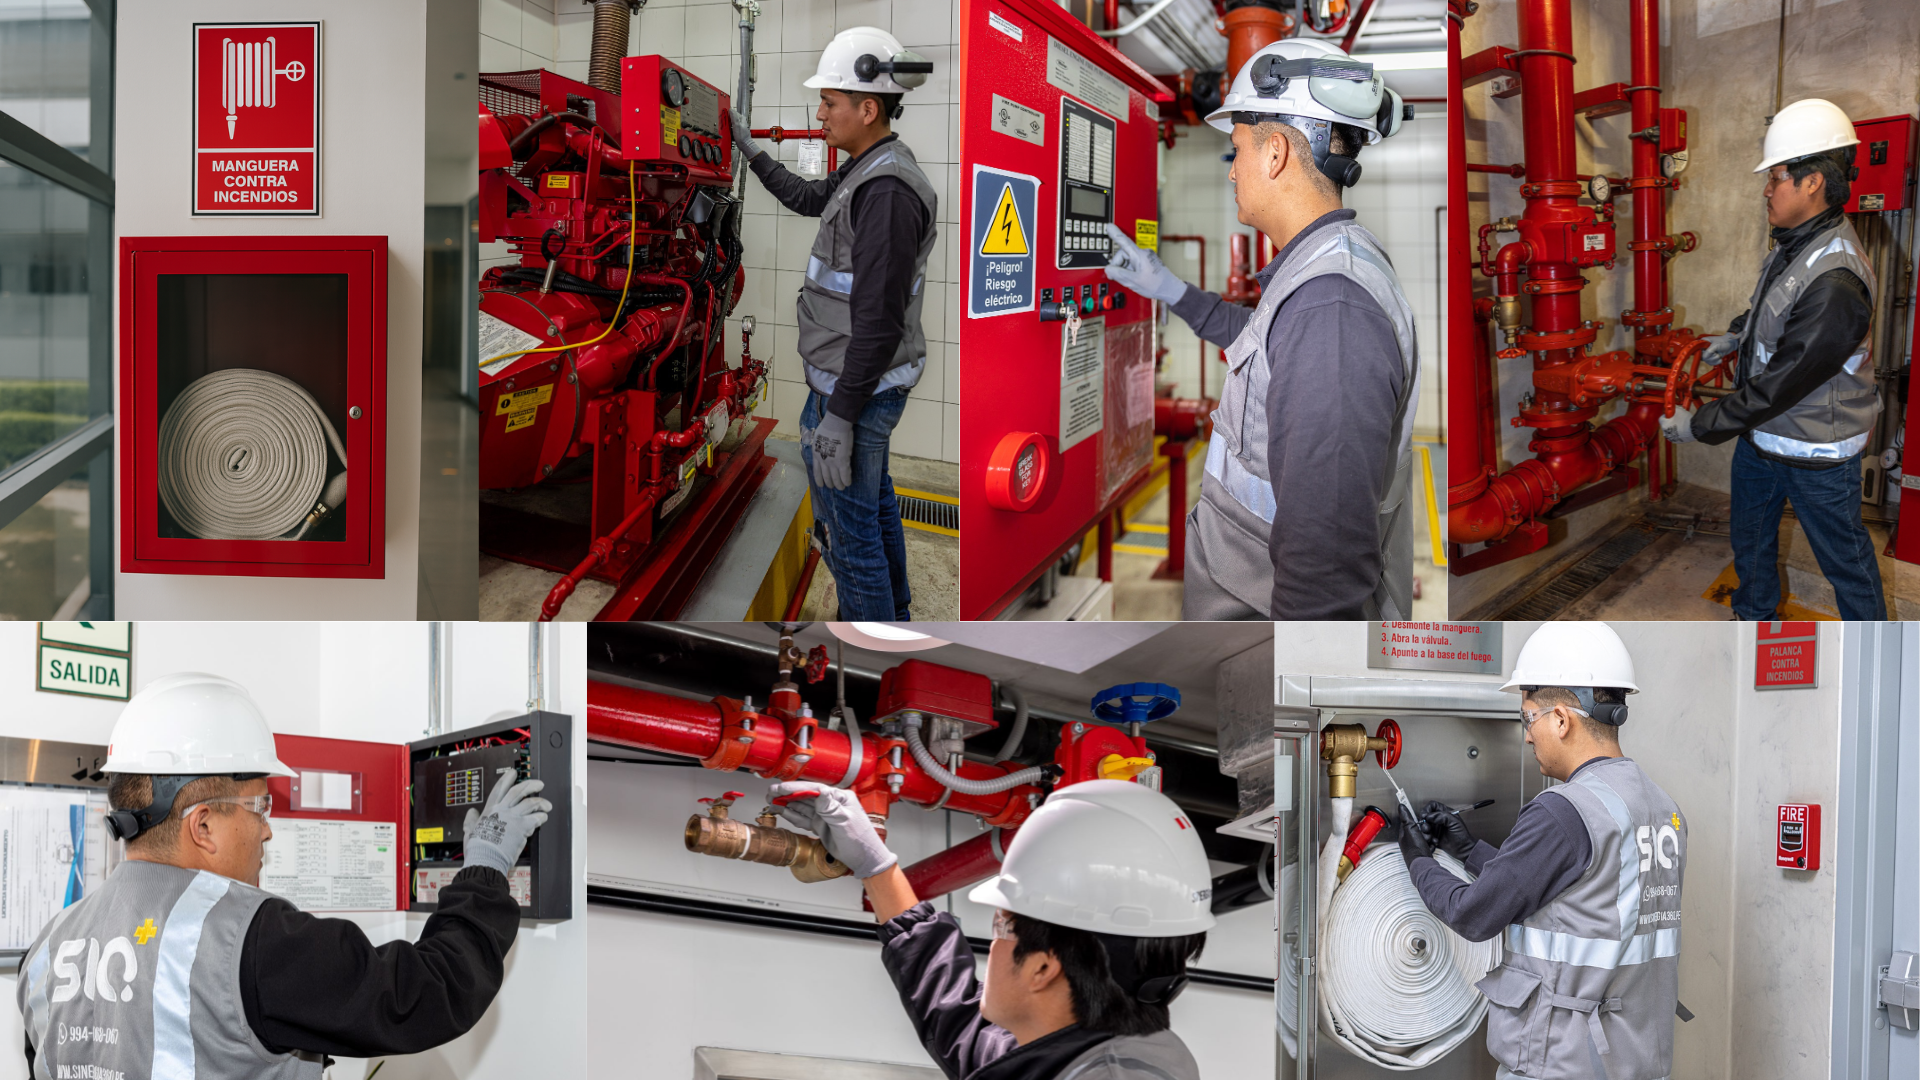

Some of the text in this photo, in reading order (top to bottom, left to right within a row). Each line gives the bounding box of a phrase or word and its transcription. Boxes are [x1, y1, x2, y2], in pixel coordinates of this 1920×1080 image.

[212, 160, 299, 172] MANGUERA
[224, 175, 287, 187] CONTRA
[214, 190, 298, 203] INCENDIOS
[986, 261, 1023, 276] ¡Peligro!
[985, 278, 1016, 291] Riesgo
[984, 292, 1023, 307] eléctrico
[1018, 453, 1033, 469] BREAK
[1391, 621, 1430, 631] Desmonte
[1432, 621, 1440, 631] la
[1442, 623, 1483, 634] manguera.
[1381, 632, 1452, 646] 3. Abra la válvula.
[1381, 646, 1494, 663] 4. Apunte a la base del fuego.
[1770, 645, 1802, 657] PALANCA
[1771, 658, 1800, 669] CONTRA
[50, 659, 120, 687] SALIDA
[1766, 670, 1804, 682] INCENDIOS
[1780, 807, 1805, 821] FIRE
